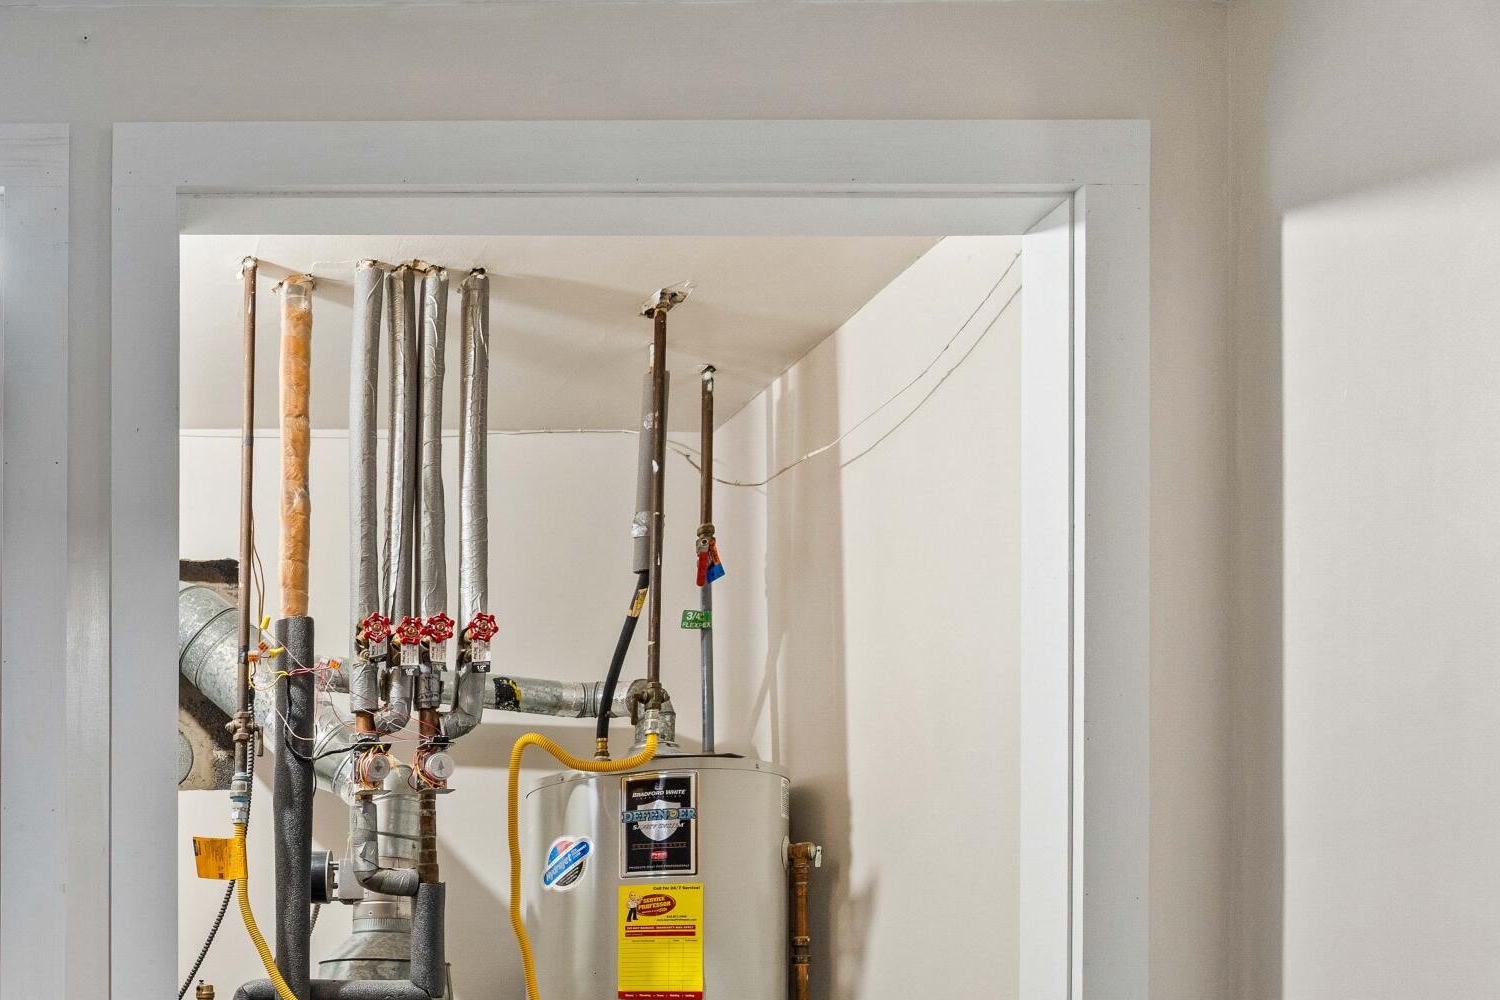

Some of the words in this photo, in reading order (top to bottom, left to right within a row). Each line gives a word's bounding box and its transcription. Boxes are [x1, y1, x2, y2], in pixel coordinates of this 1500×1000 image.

[632, 790, 665, 798] BRADFORD
[622, 808, 697, 823] DEFENDER
[643, 896, 665, 904] SERVICE
[637, 901, 671, 910] PROFESSOR
